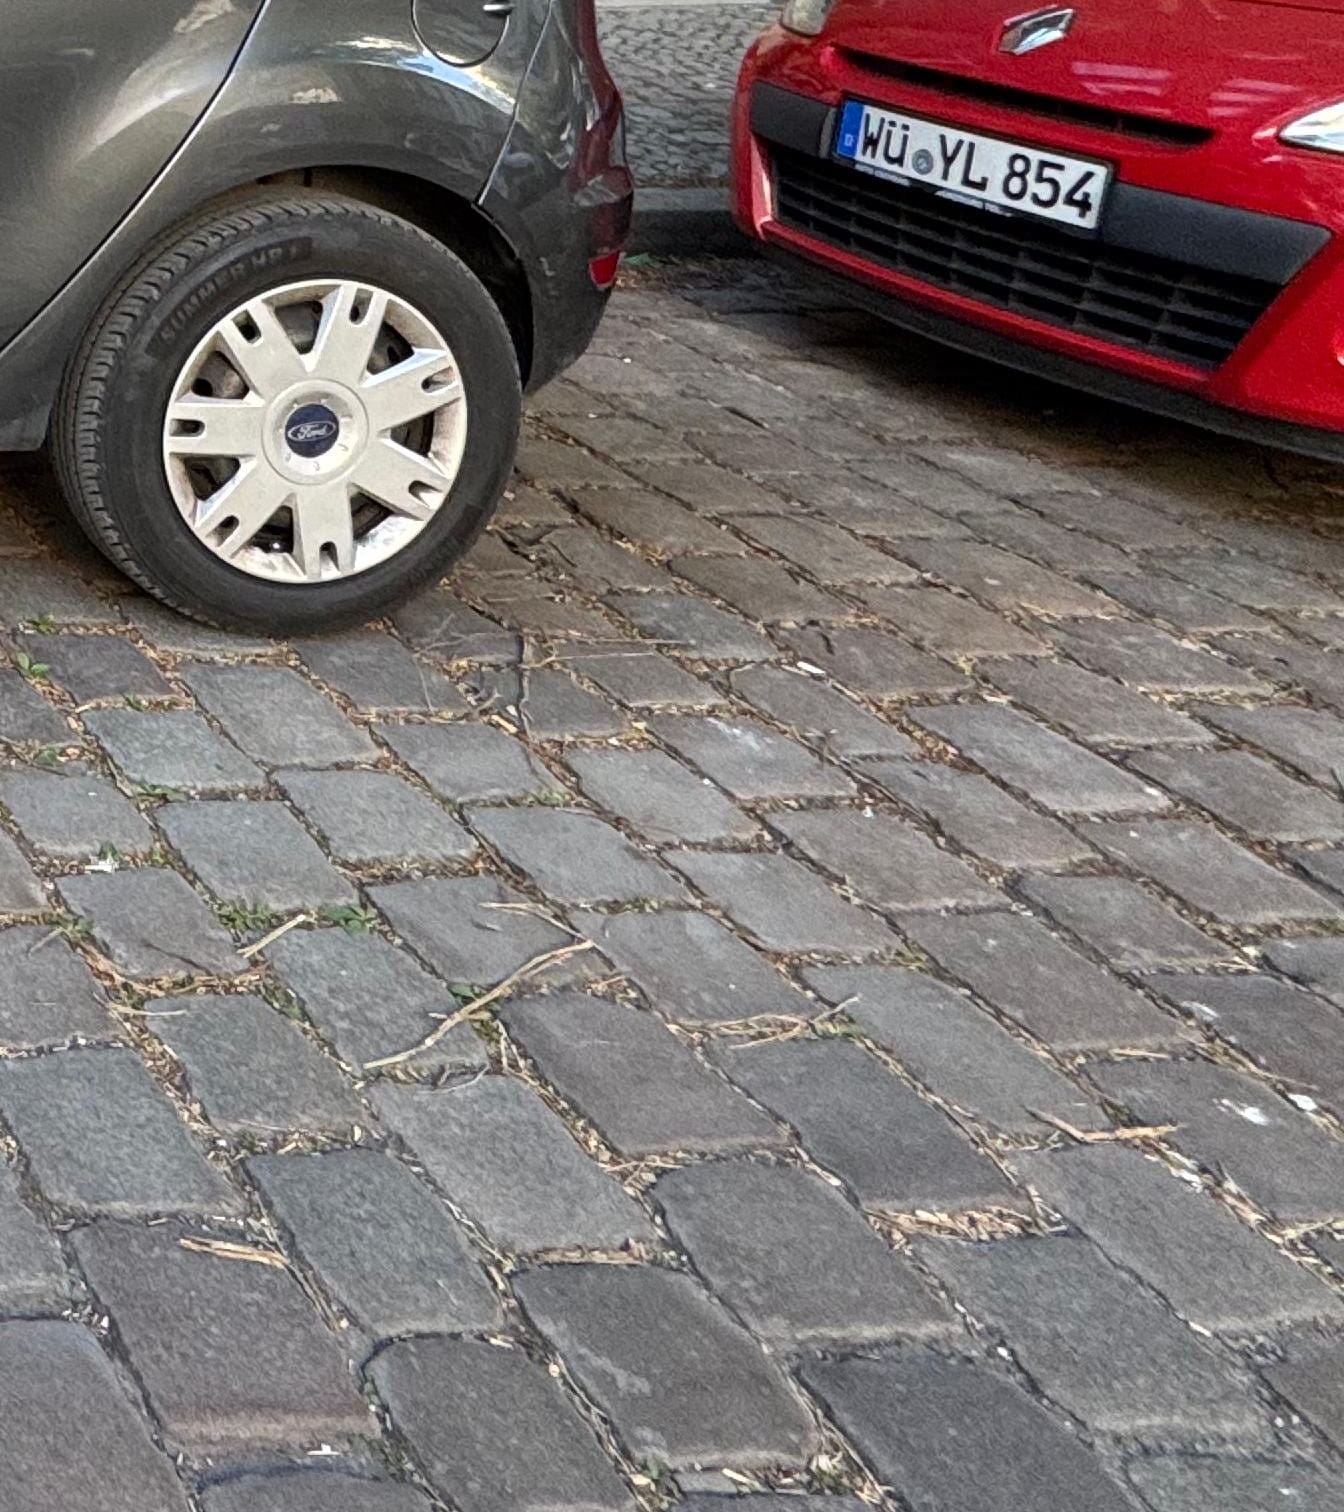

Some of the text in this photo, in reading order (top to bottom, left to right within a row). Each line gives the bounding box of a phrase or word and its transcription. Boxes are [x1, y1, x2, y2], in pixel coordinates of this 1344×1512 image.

[861, 112, 1097, 219] WÜ YL 854
[293, 422, 330, 440] Ford
